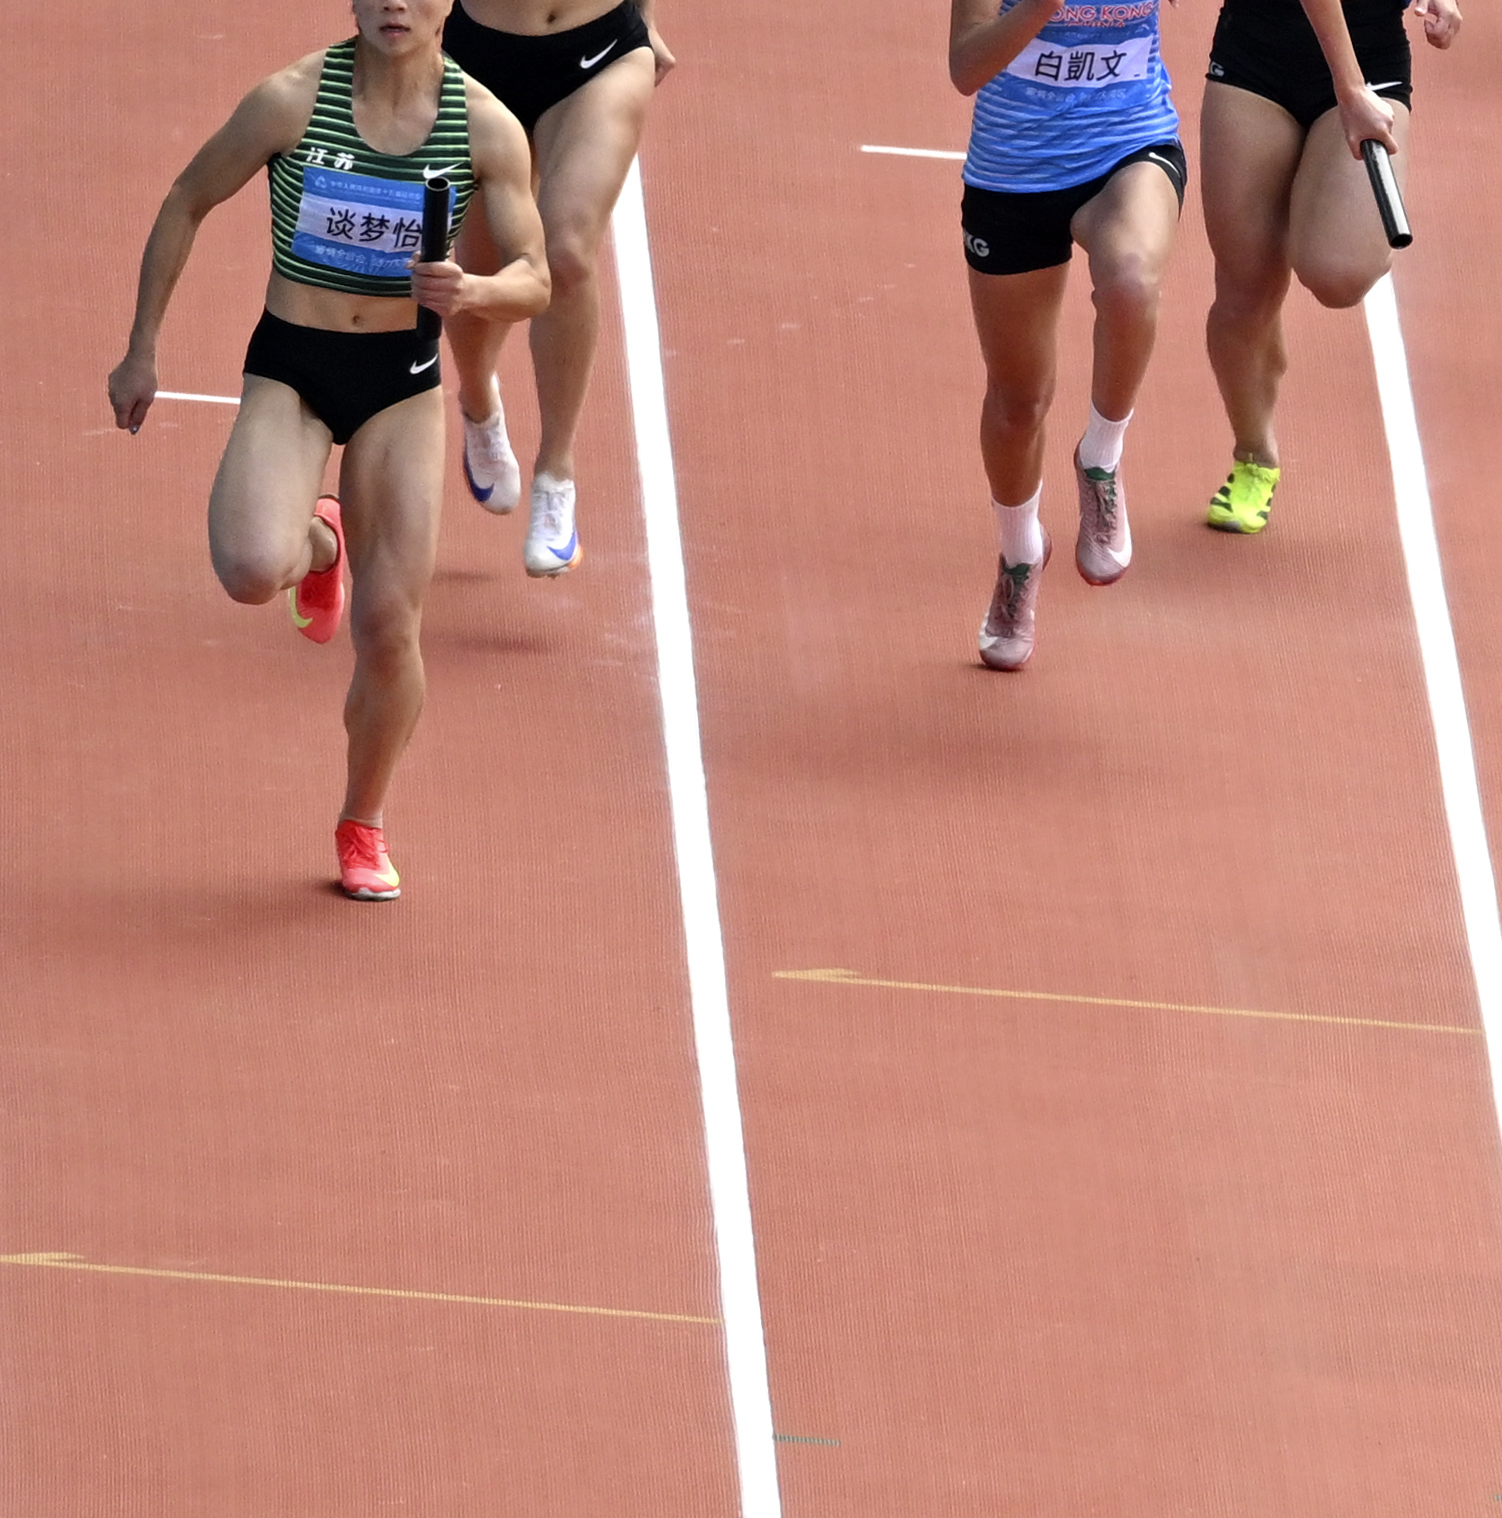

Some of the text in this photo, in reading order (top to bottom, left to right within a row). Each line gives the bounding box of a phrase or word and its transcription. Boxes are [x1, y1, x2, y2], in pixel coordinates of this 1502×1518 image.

[1050, 1, 1154, 22] ONG KONG
[1035, 50, 1127, 81] 白凱文
[305, 146, 356, 170] 江苏
[326, 207, 422, 248] 谈梦怡
